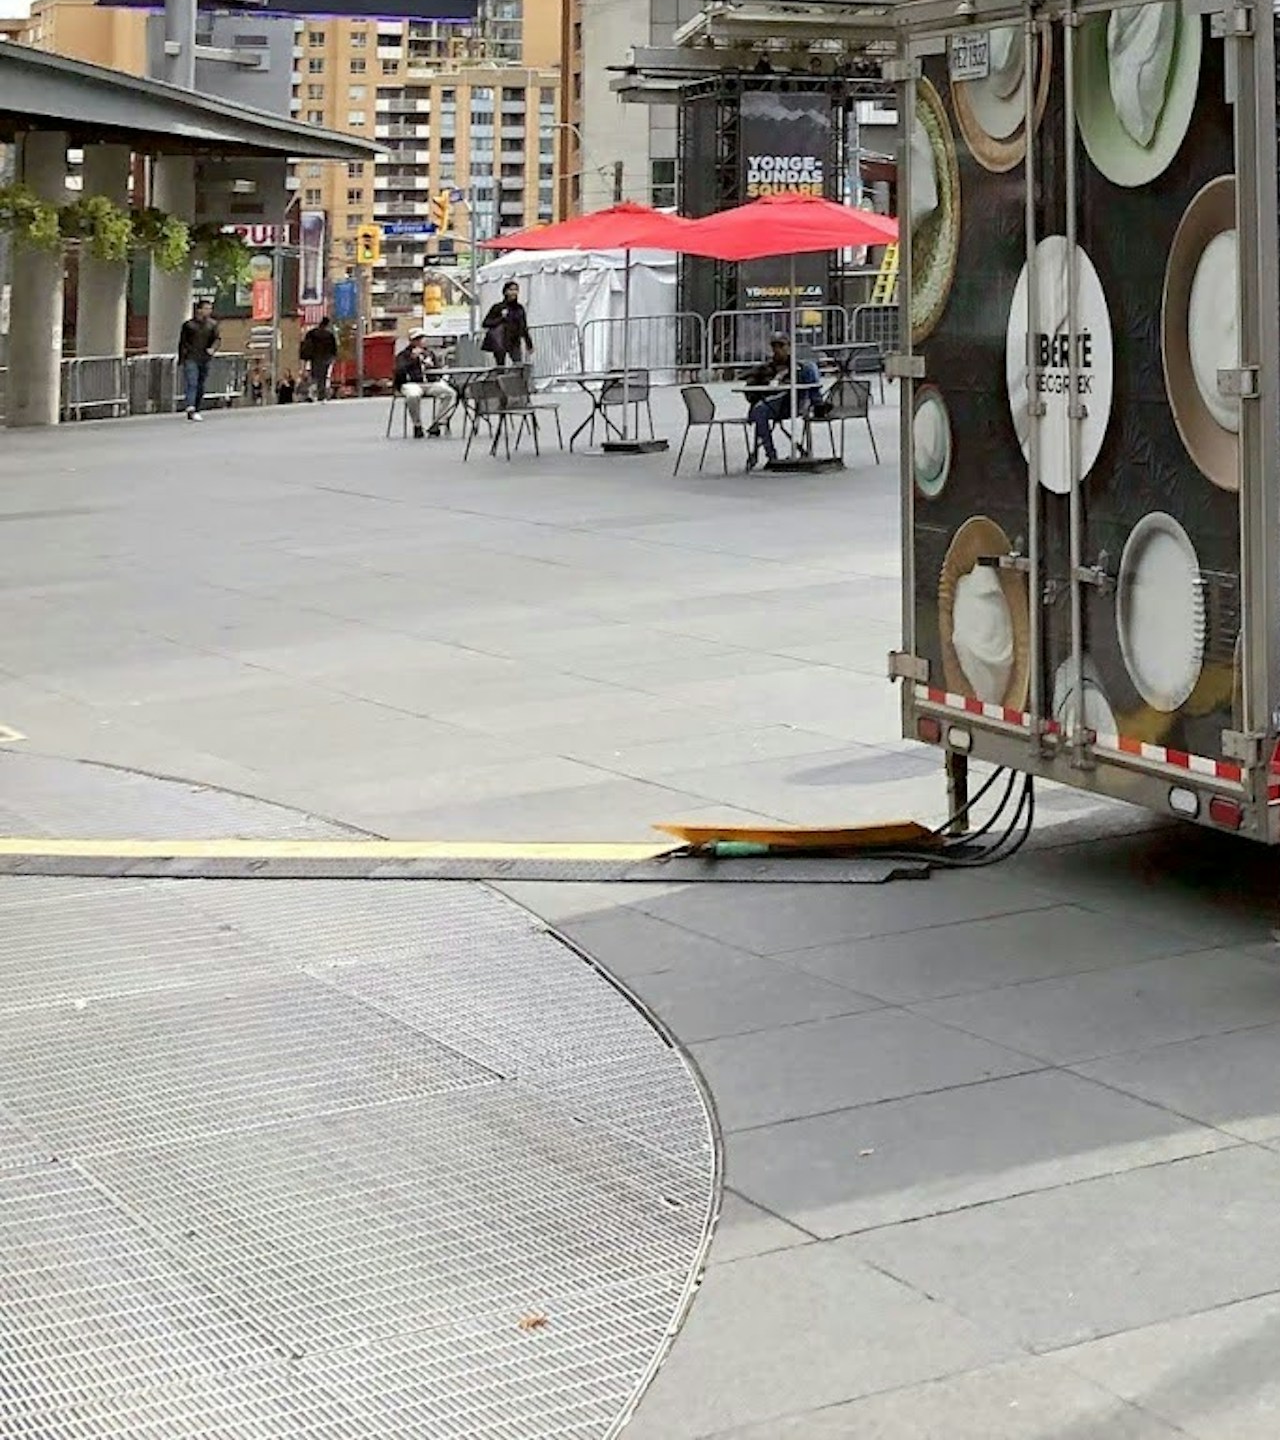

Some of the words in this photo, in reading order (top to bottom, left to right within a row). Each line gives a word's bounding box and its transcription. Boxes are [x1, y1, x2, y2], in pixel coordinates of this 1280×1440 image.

[747, 156, 823, 171] YONGE-
[747, 170, 823, 183] DUNDAS
[746, 183, 823, 197] SQUARE
